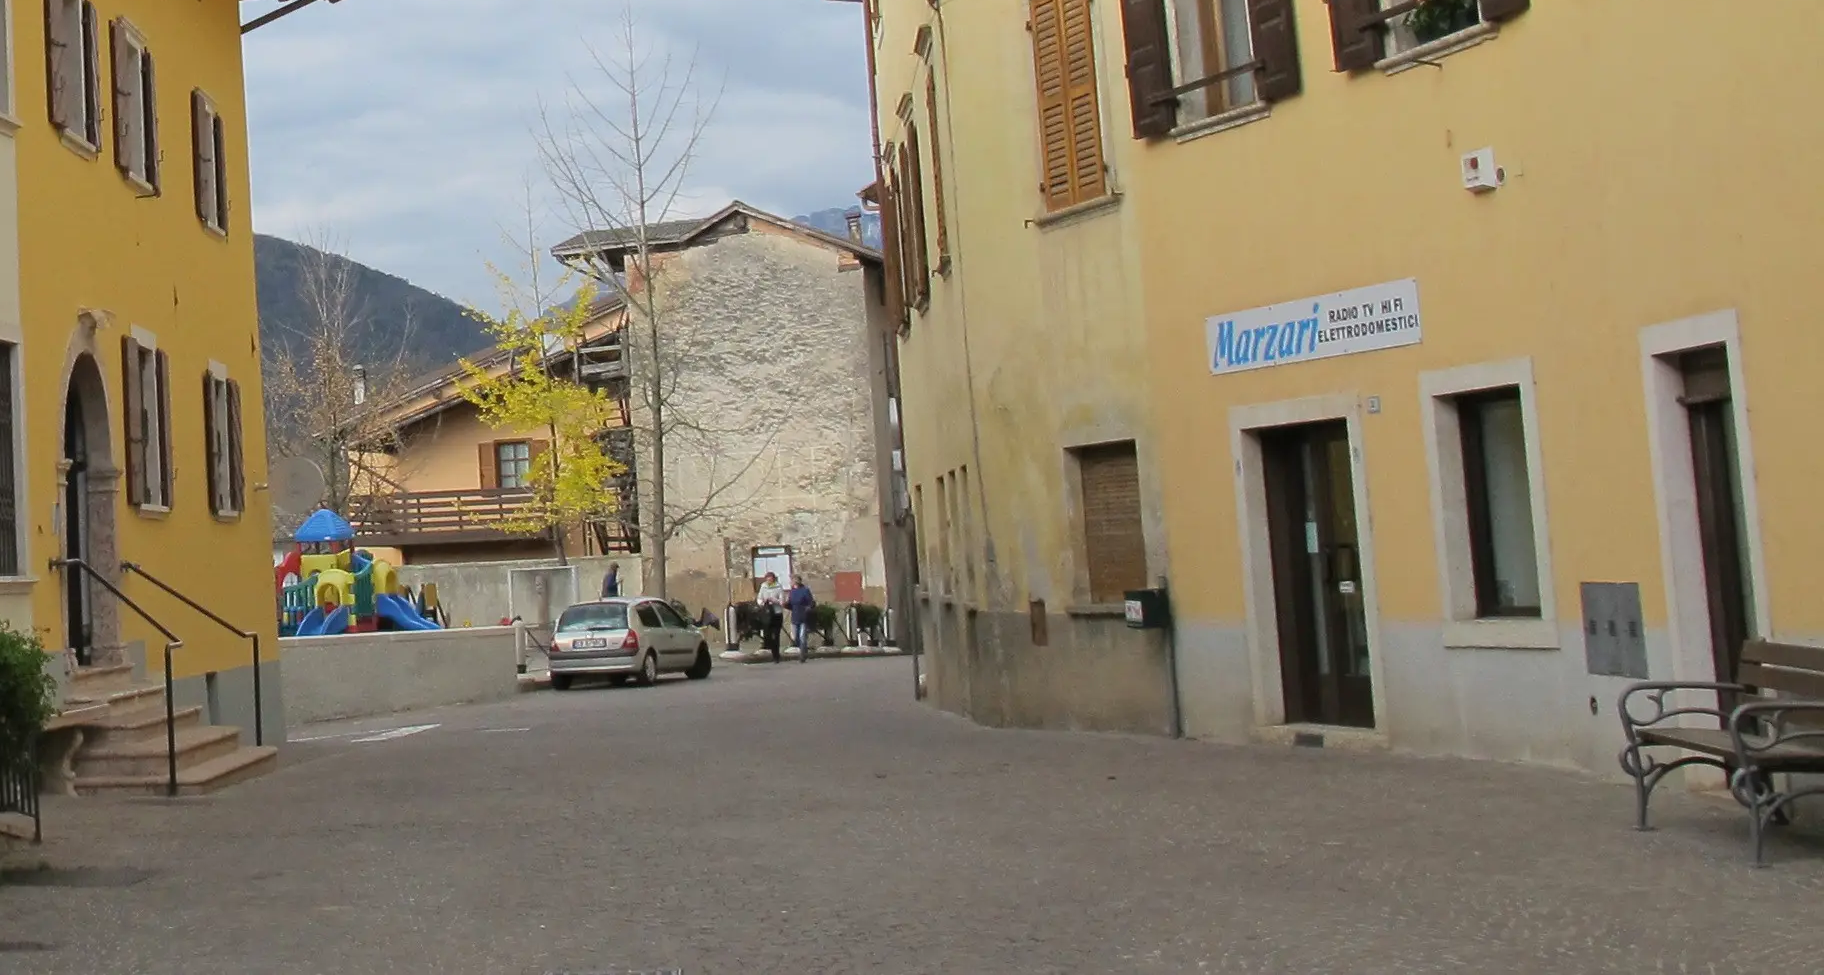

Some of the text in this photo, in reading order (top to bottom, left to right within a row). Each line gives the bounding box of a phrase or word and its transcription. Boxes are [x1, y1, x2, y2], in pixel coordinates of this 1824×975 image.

[1328, 307, 1358, 323] RADIO
[1362, 303, 1374, 318] TV
[1214, 302, 1320, 369] Marzari
[1317, 314, 1419, 343] ELETTRODOMESTICI
